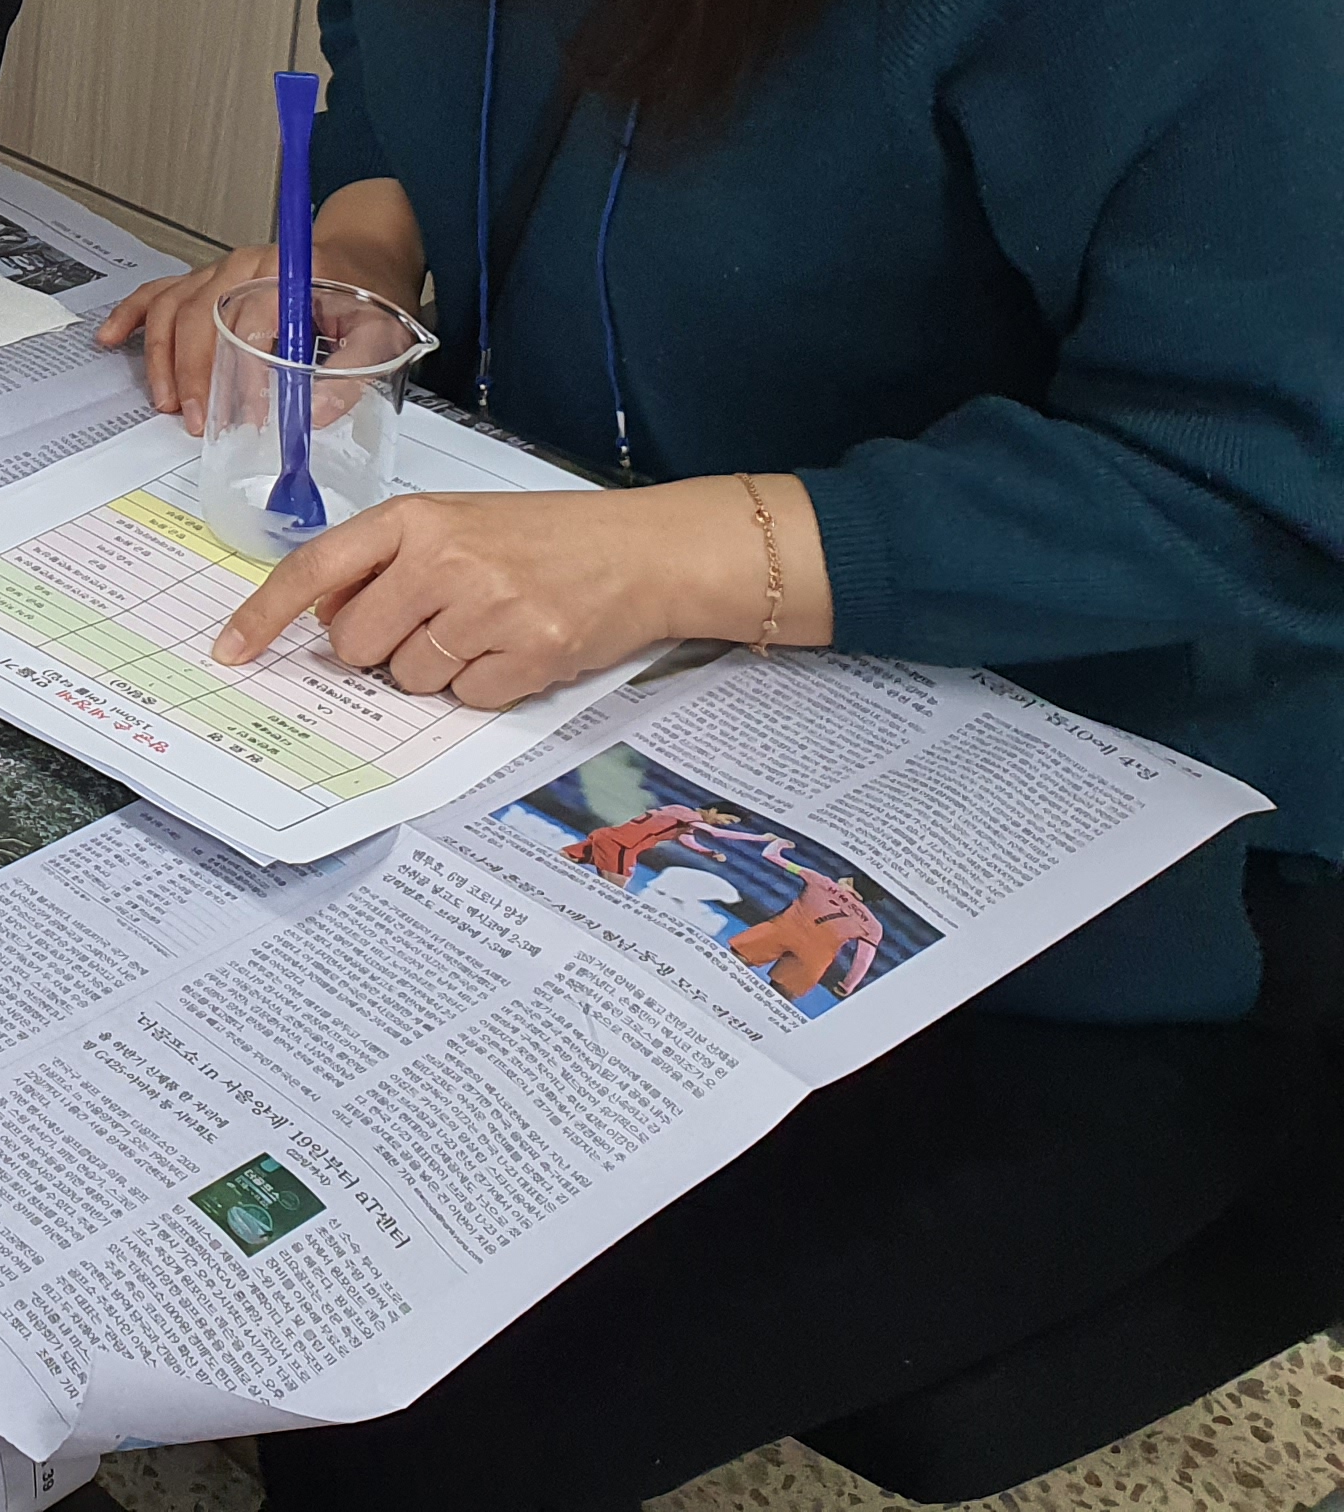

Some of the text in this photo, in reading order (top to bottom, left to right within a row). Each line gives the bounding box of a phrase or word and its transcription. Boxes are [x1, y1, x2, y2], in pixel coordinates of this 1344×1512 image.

[54, 683, 111, 720] 세정제
[317, 703, 334, 715] CA
[109, 706, 154, 736] 150ml
[112, 719, 134, 731] 손
[296, 713, 318, 726] LPB
[132, 727, 170, 754] 항균
[446, 871, 469, 889] 6명
[465, 884, 503, 911] 코로나
[503, 905, 529, 926] 양성
[466, 896, 511, 945] 멕시코에
[112, 1041, 148, 1068] 하반기
[192, 1100, 230, 1129] 자리에
[197, 1062, 219, 1081] in
[288, 1130, 360, 1190] 19일부터
[354, 1191, 411, 1249] aT센터
